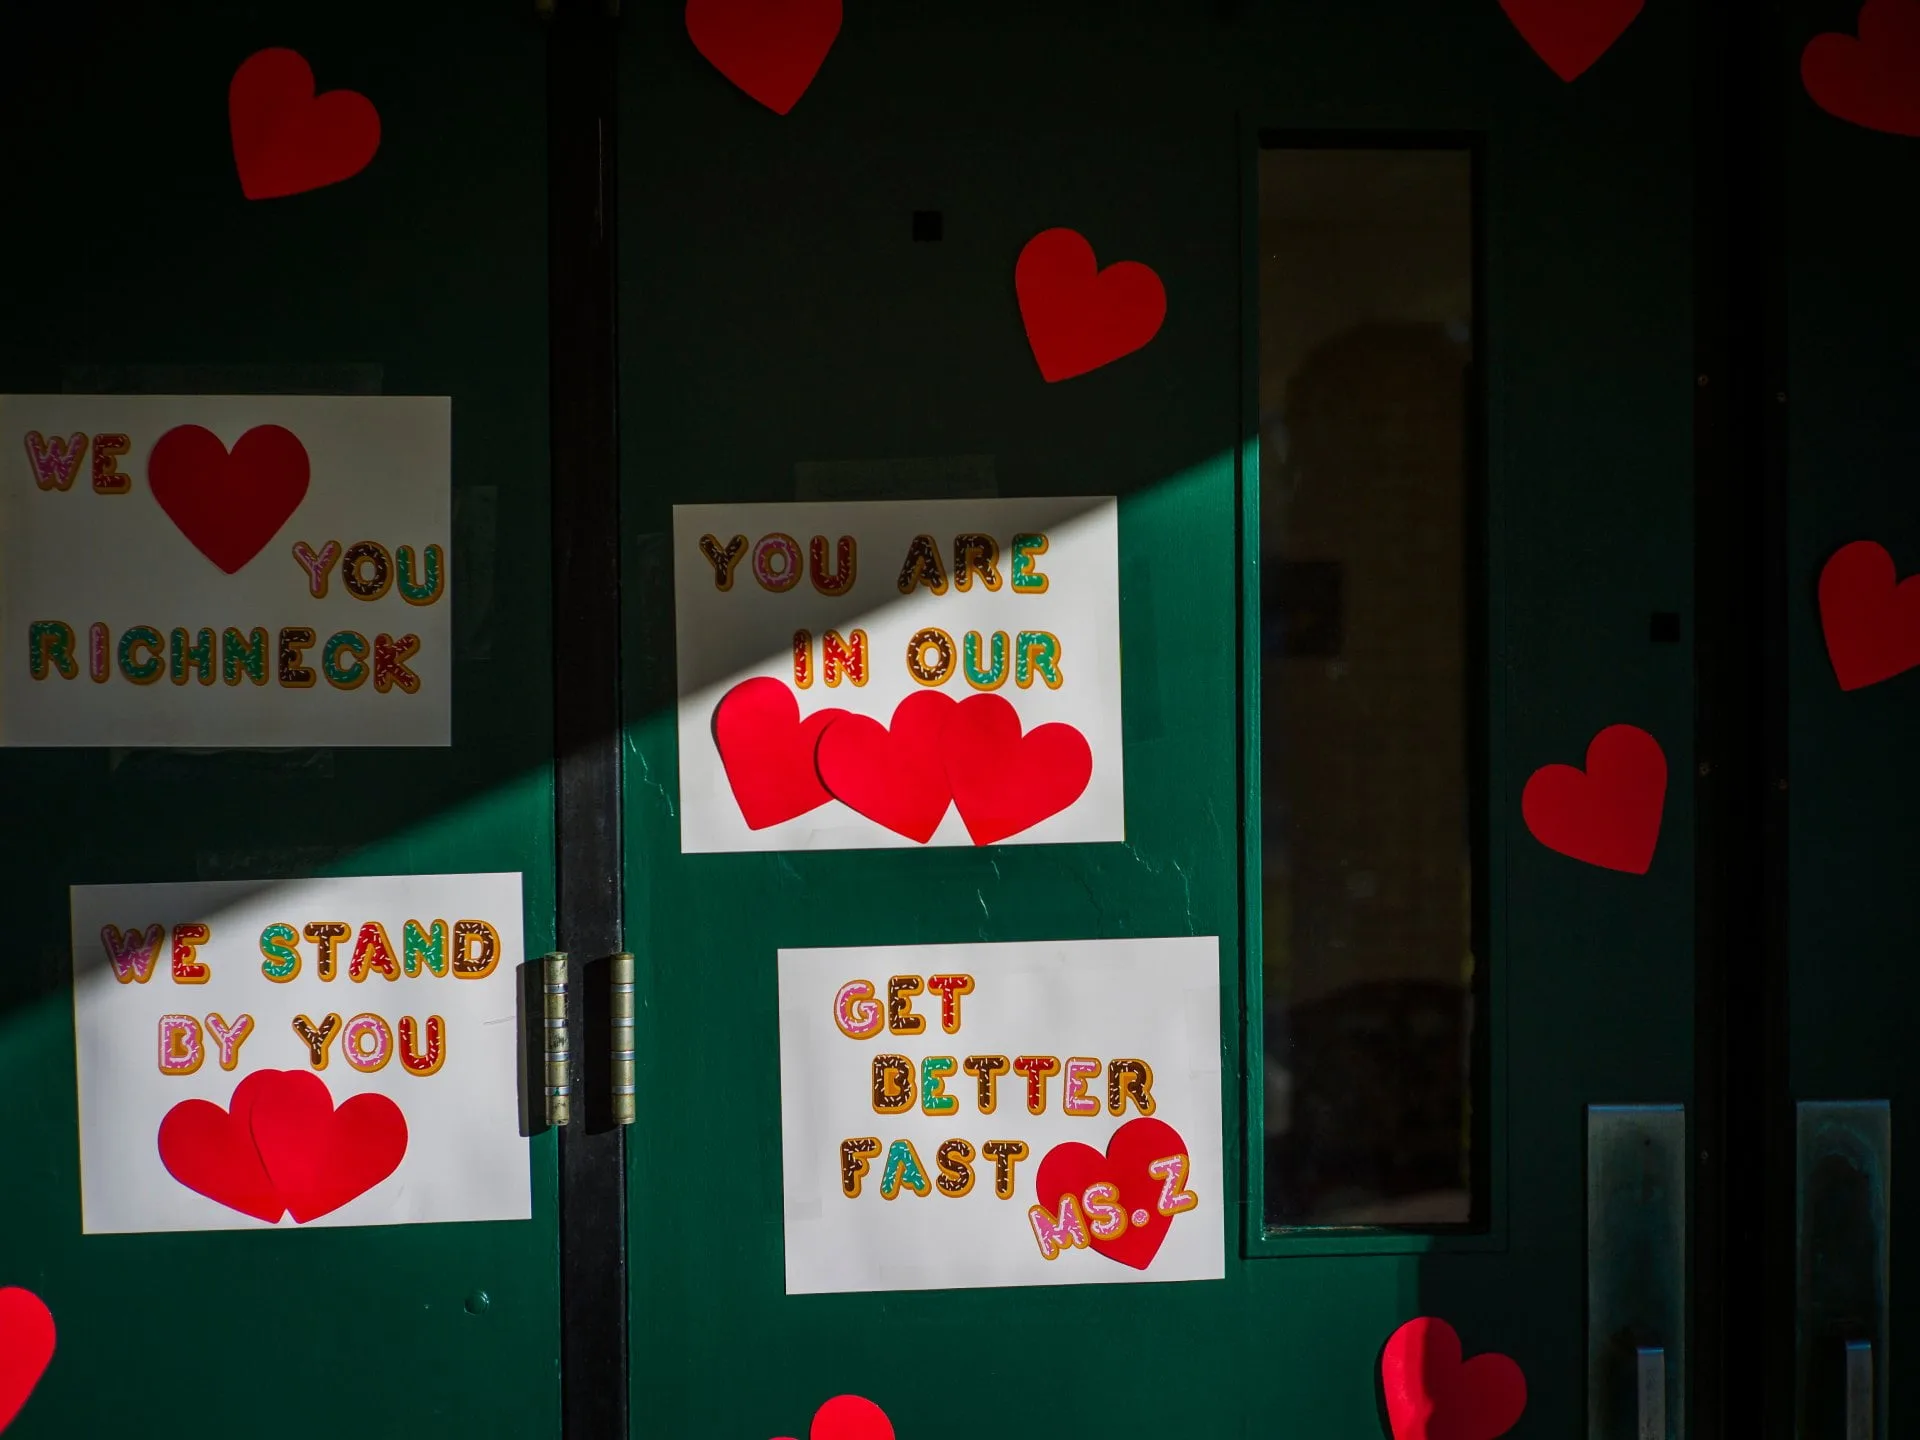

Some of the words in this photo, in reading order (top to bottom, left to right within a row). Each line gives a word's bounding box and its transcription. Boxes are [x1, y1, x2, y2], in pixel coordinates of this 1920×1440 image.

[24, 430, 131, 494] WE
[292, 540, 444, 606] YOU
[699, 532, 857, 596] YOU
[898, 533, 1049, 596] ARE
[29, 620, 421, 694] RICHNECK
[793, 628, 869, 690] IN
[906, 627, 1063, 691] OUR
[101, 923, 210, 984] WE
[260, 919, 500, 983] STAND
[833, 974, 975, 1040] GET
[158, 1012, 254, 1076] BY
[293, 1012, 446, 1076] YOU
[872, 1054, 1156, 1117] BETTER
[840, 1136, 1029, 1200] FAST
